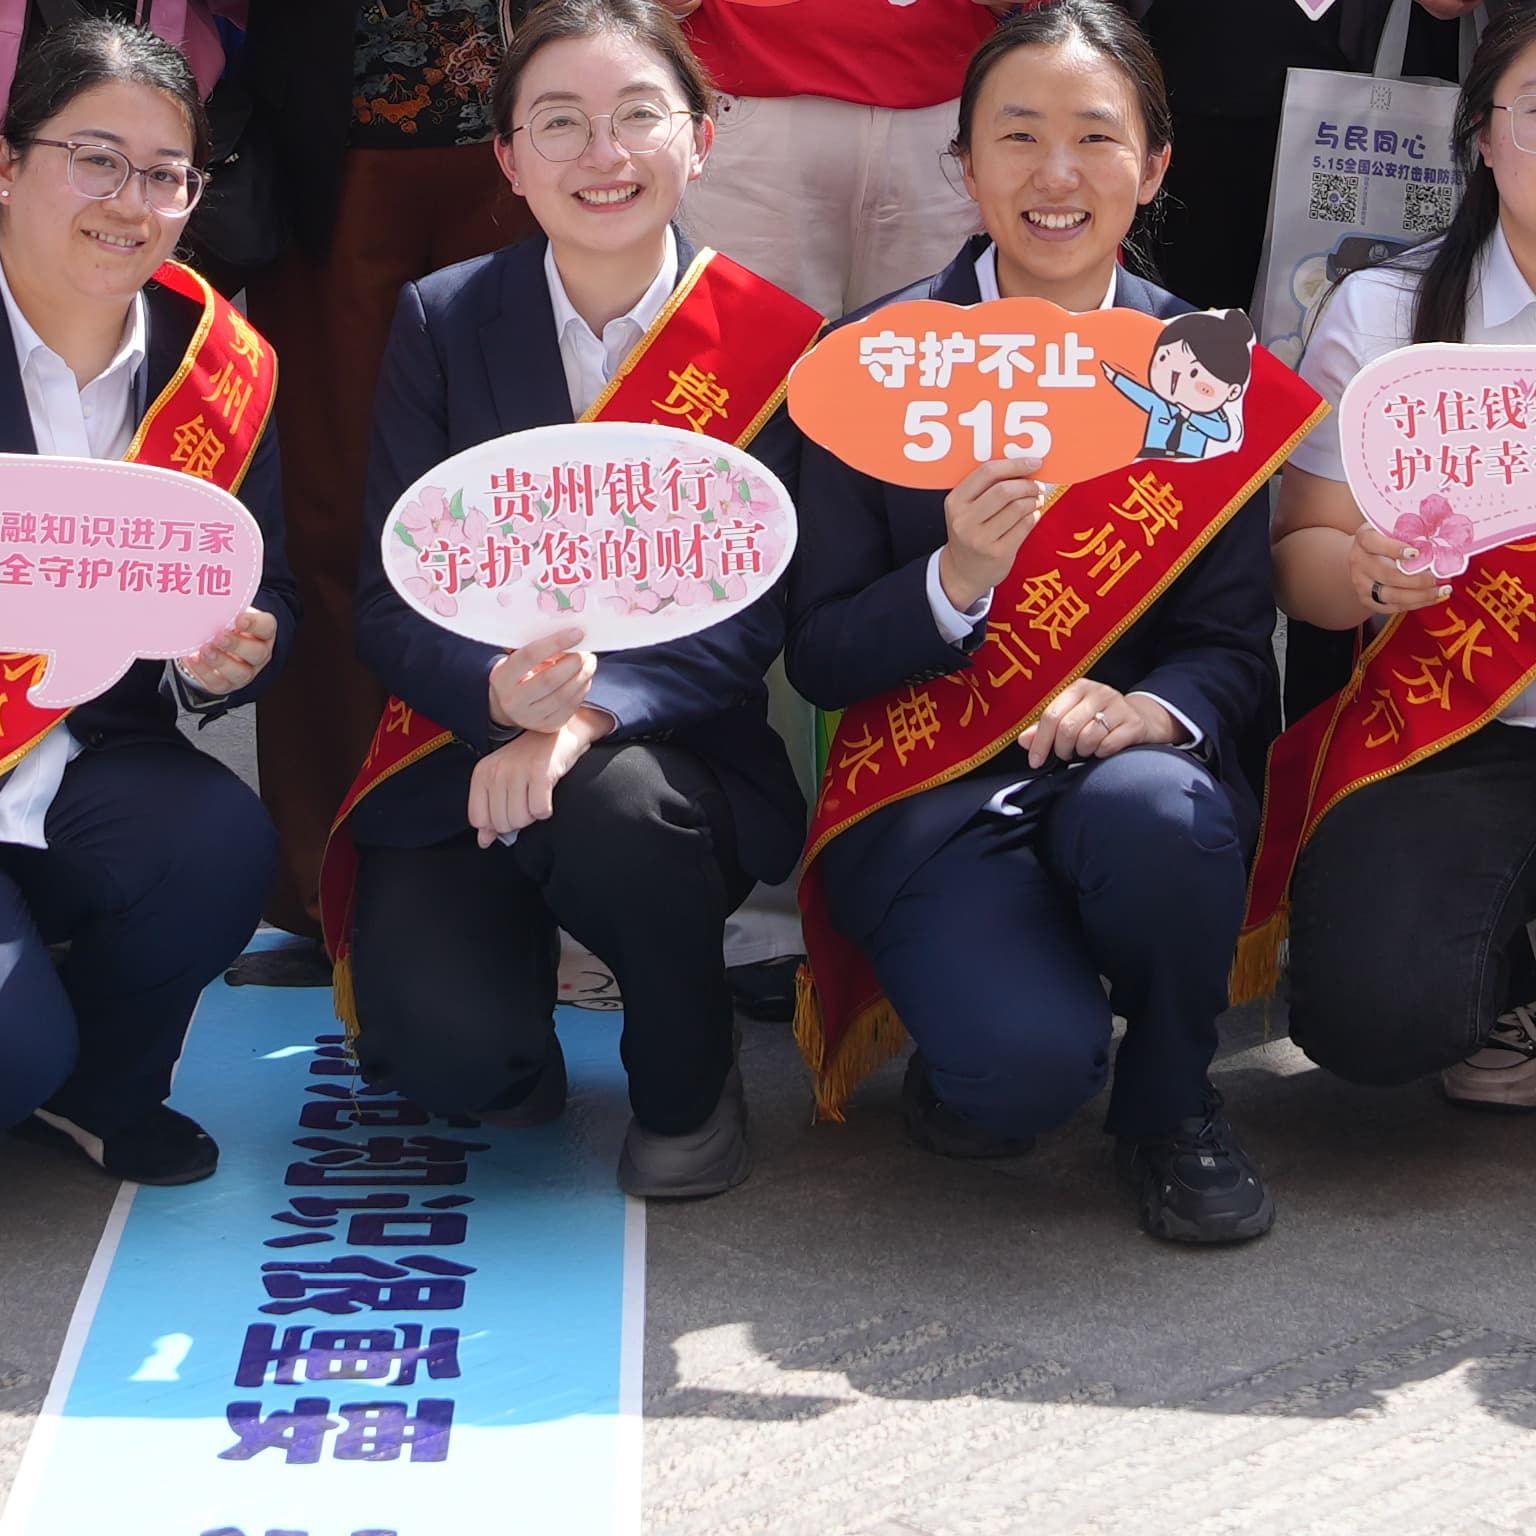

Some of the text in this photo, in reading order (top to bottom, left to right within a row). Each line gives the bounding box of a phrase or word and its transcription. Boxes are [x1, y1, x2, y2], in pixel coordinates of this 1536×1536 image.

[1315, 120, 1427, 161] 与民同心
[859, 330, 1097, 390] 守护不止
[902, 399, 1053, 463] 515
[483, 456, 717, 527] 贵州银行
[419, 519, 768, 595] 守护您的财富
